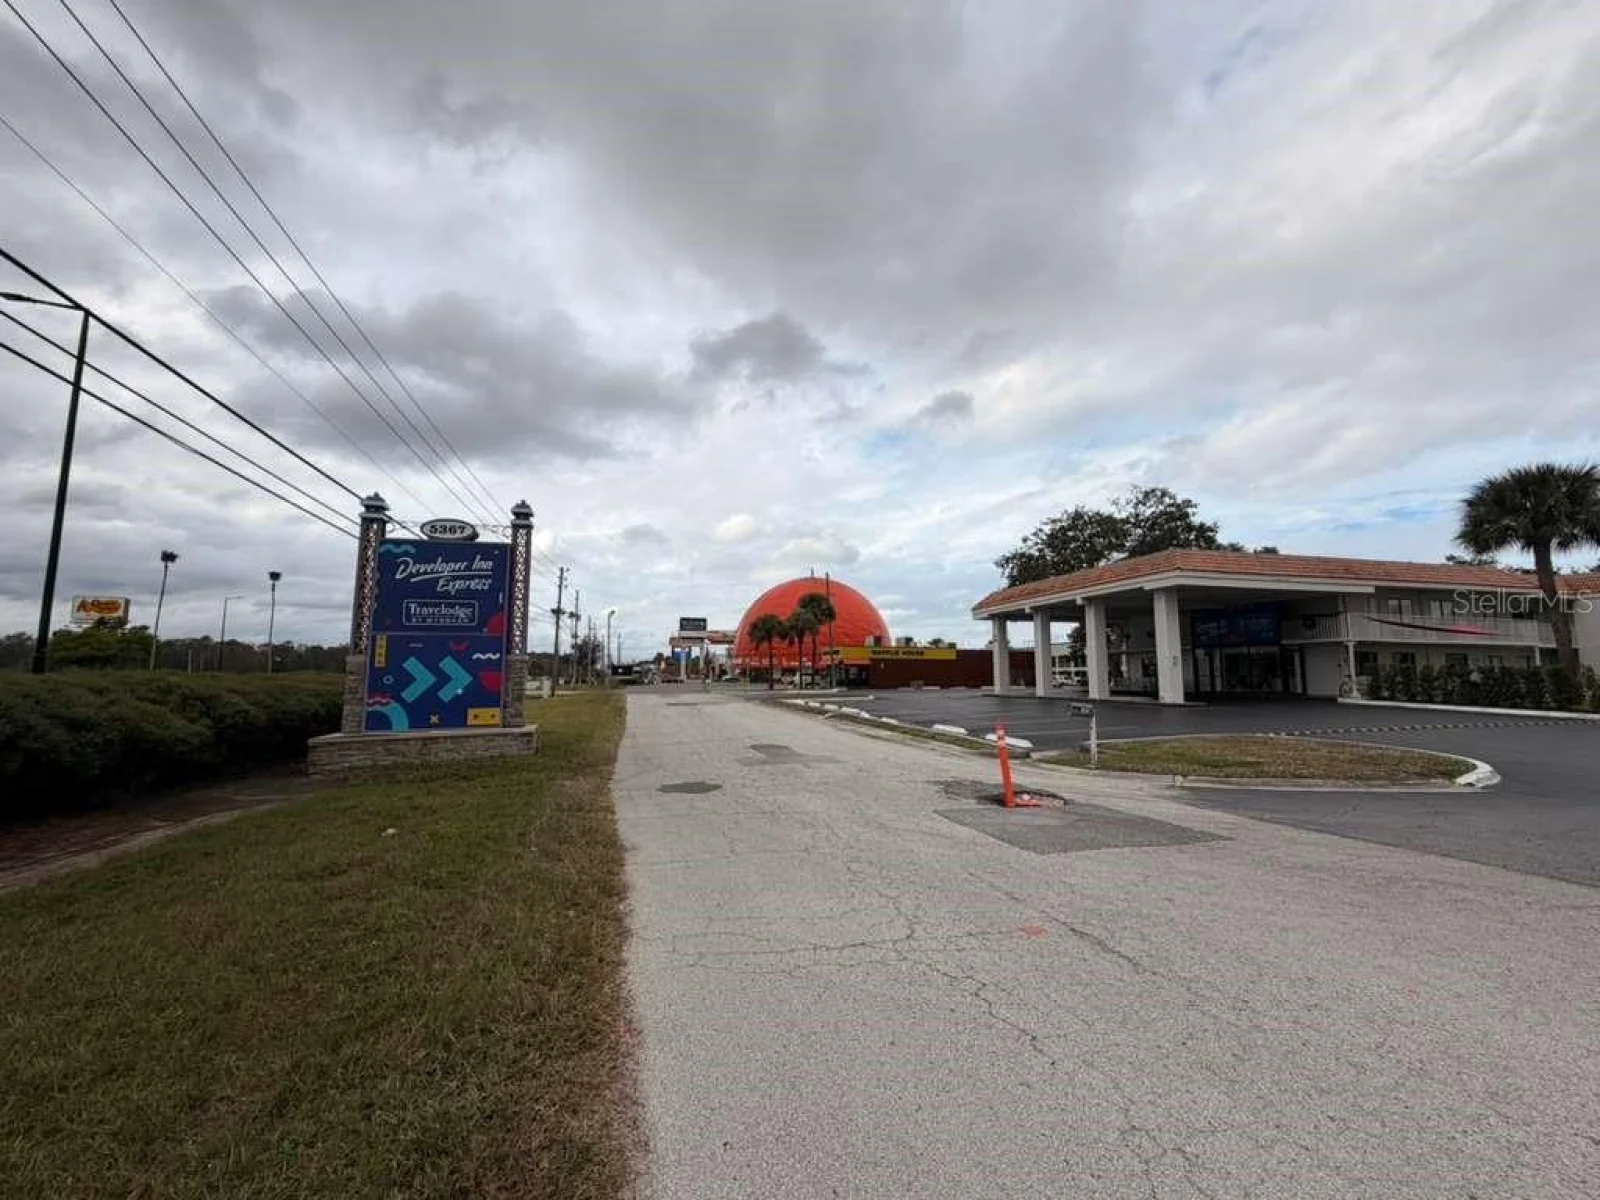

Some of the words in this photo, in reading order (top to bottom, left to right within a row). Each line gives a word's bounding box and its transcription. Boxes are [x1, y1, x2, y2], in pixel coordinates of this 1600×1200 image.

[430, 524, 465, 534] 5367
[396, 556, 467, 579] Developer
[472, 554, 493, 570] Inn
[437, 577, 491, 595] Express
[410, 603, 473, 617] Travelodge
